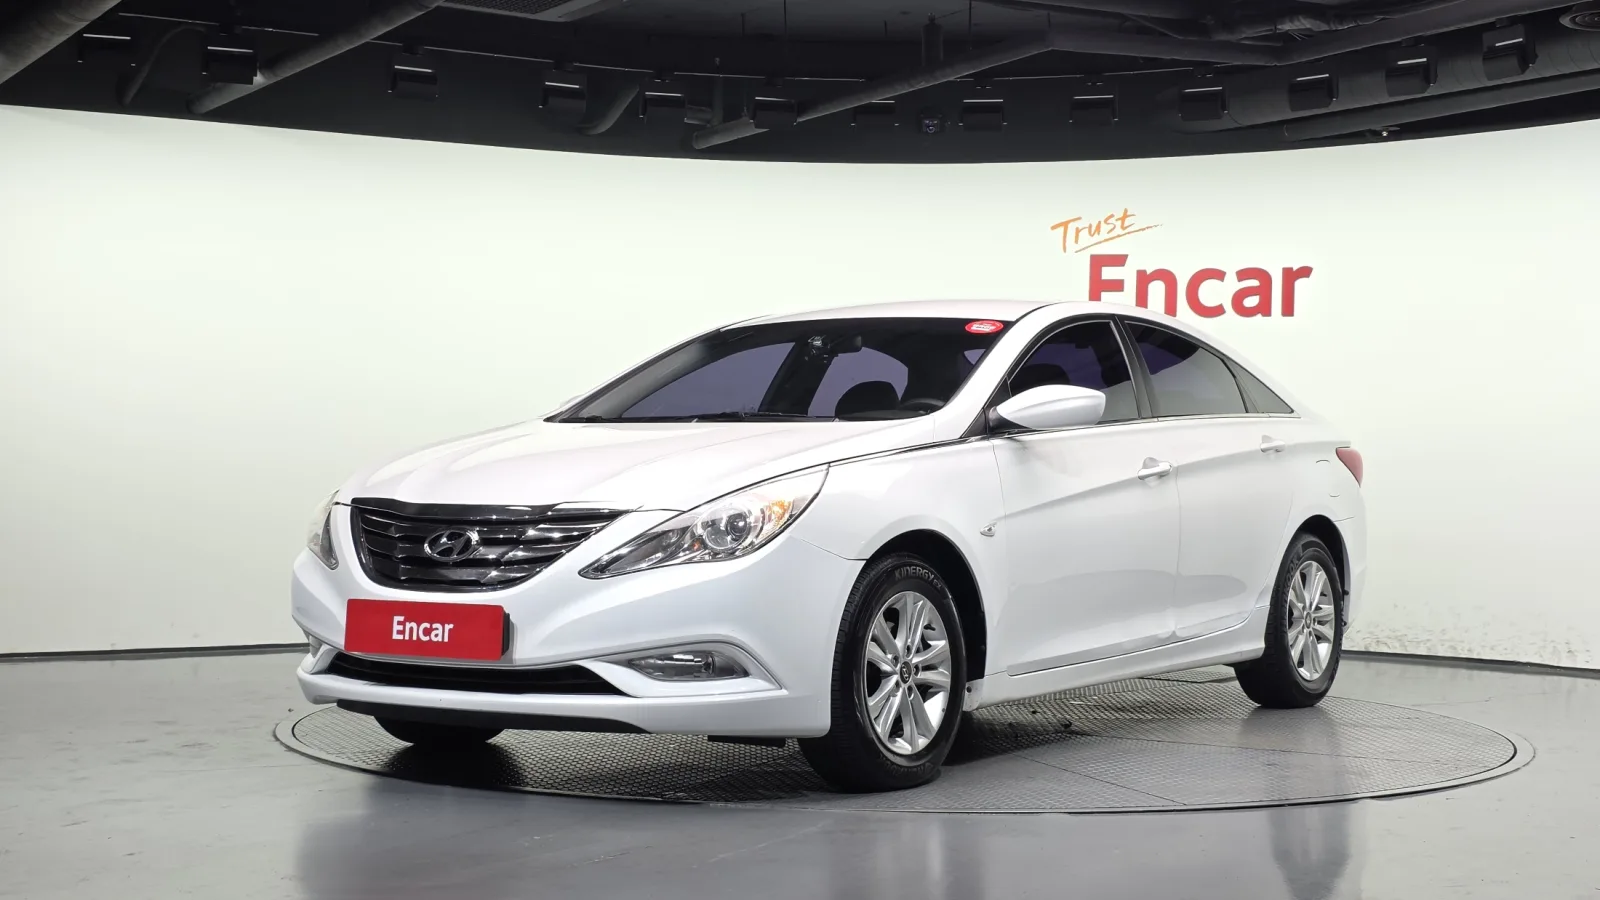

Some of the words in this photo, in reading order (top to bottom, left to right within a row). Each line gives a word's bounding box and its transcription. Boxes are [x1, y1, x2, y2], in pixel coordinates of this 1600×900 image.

[1050, 208, 1138, 253] Trust
[1088, 254, 1314, 318] Encar
[391, 615, 454, 643] Encar
